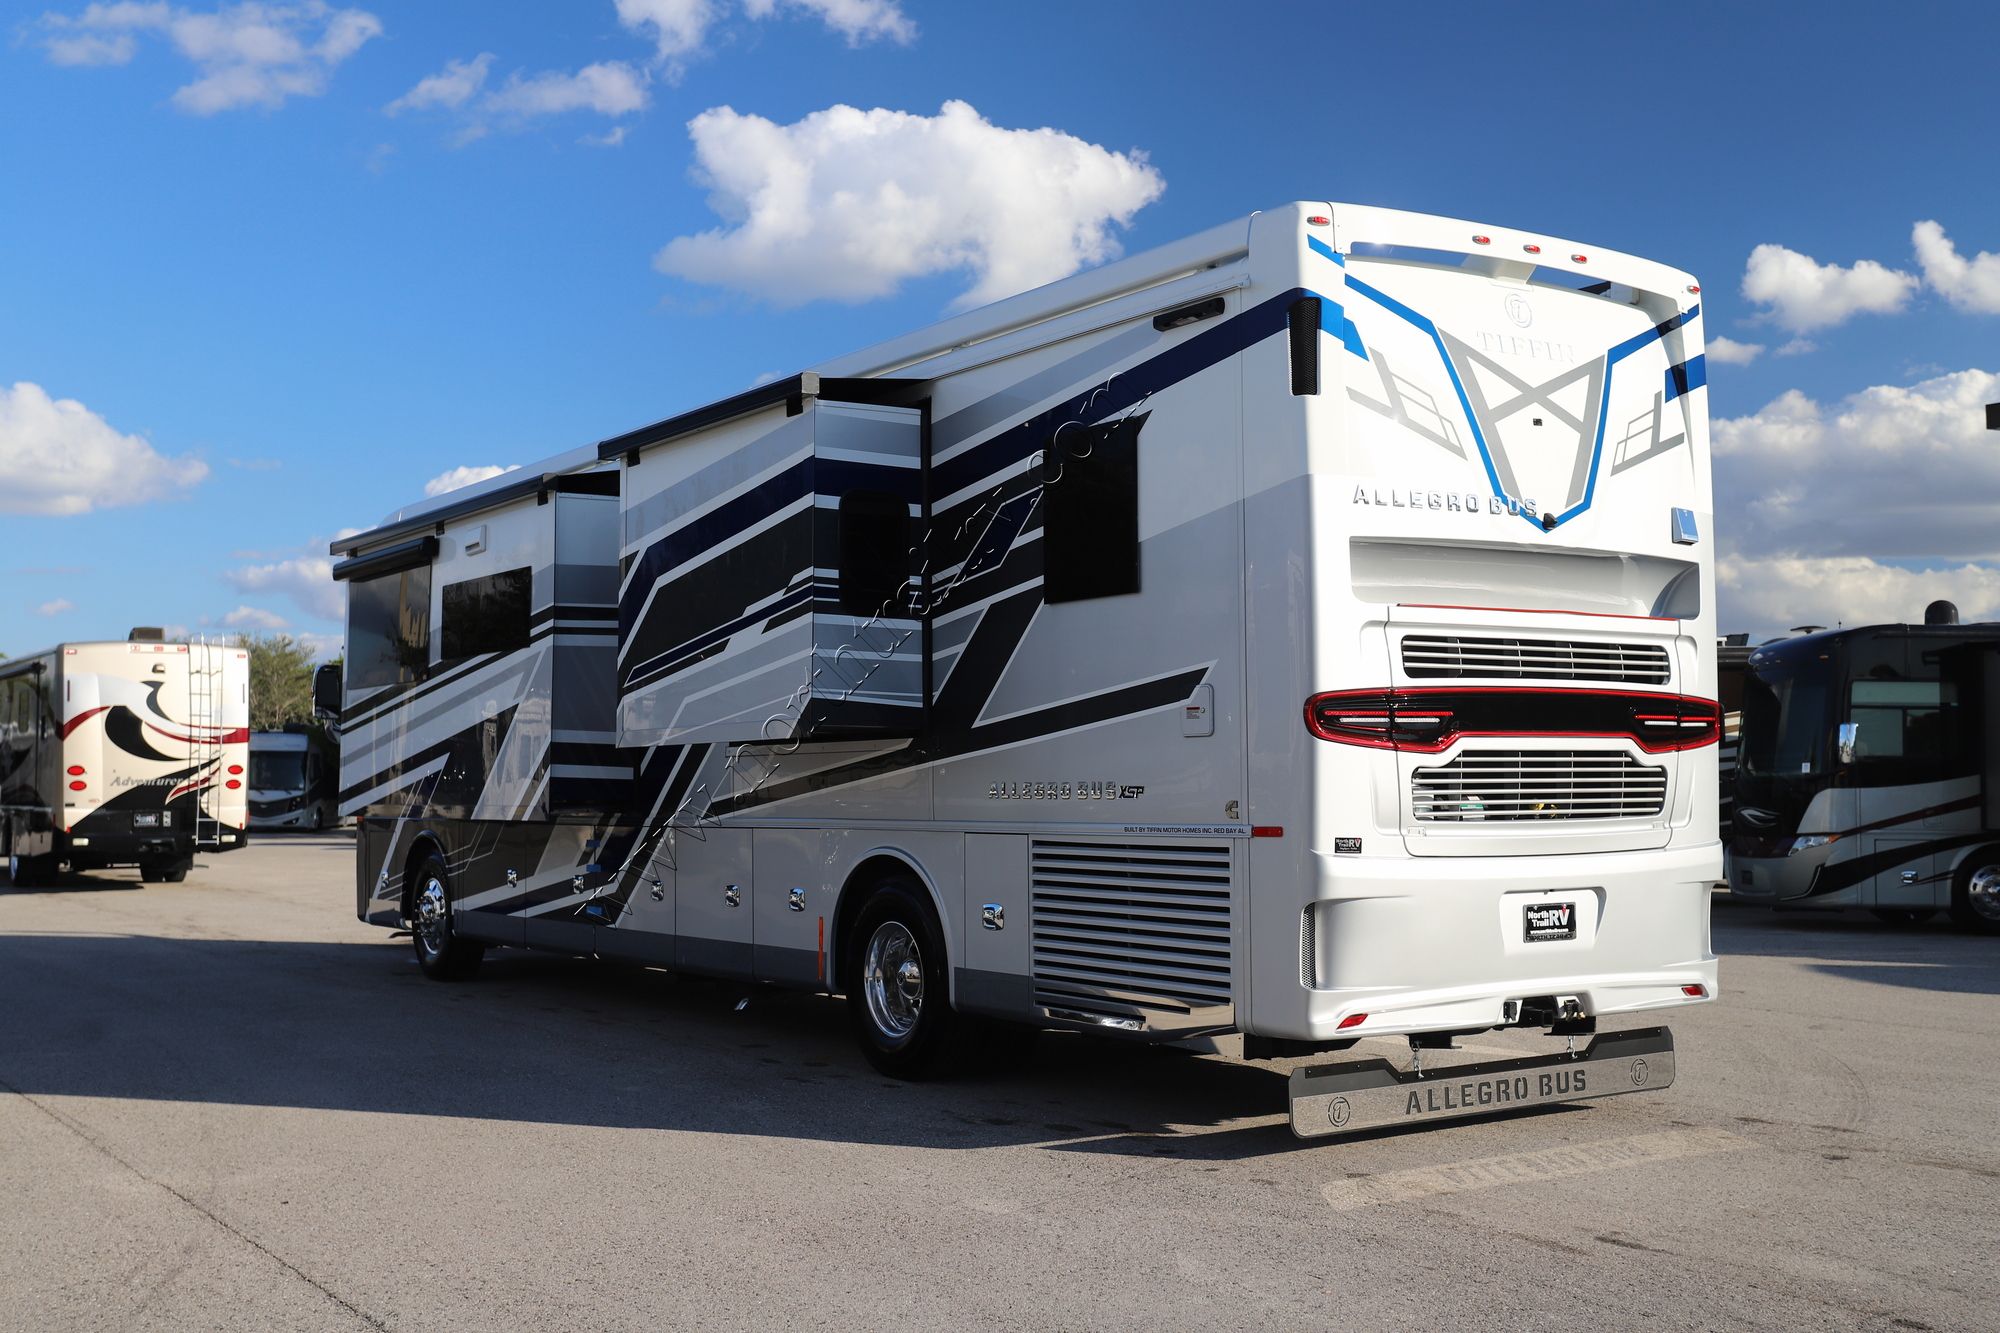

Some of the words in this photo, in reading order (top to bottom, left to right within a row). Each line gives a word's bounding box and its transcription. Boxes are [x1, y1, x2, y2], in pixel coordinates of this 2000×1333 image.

[1353, 484, 1479, 513] ALLEGRO
[1489, 496, 1537, 517] BUS
[110, 775, 184, 787] Adventurer
[989, 781, 1071, 800] ALLEGRO
[1077, 781, 1117, 800] BUS
[1527, 910, 1549, 920] North
[1549, 908, 1570, 926] RV
[1531, 918, 1549, 927] Trail
[1405, 1076, 1528, 1115] ALLEGRO
[1538, 1069, 1586, 1097] BUS
